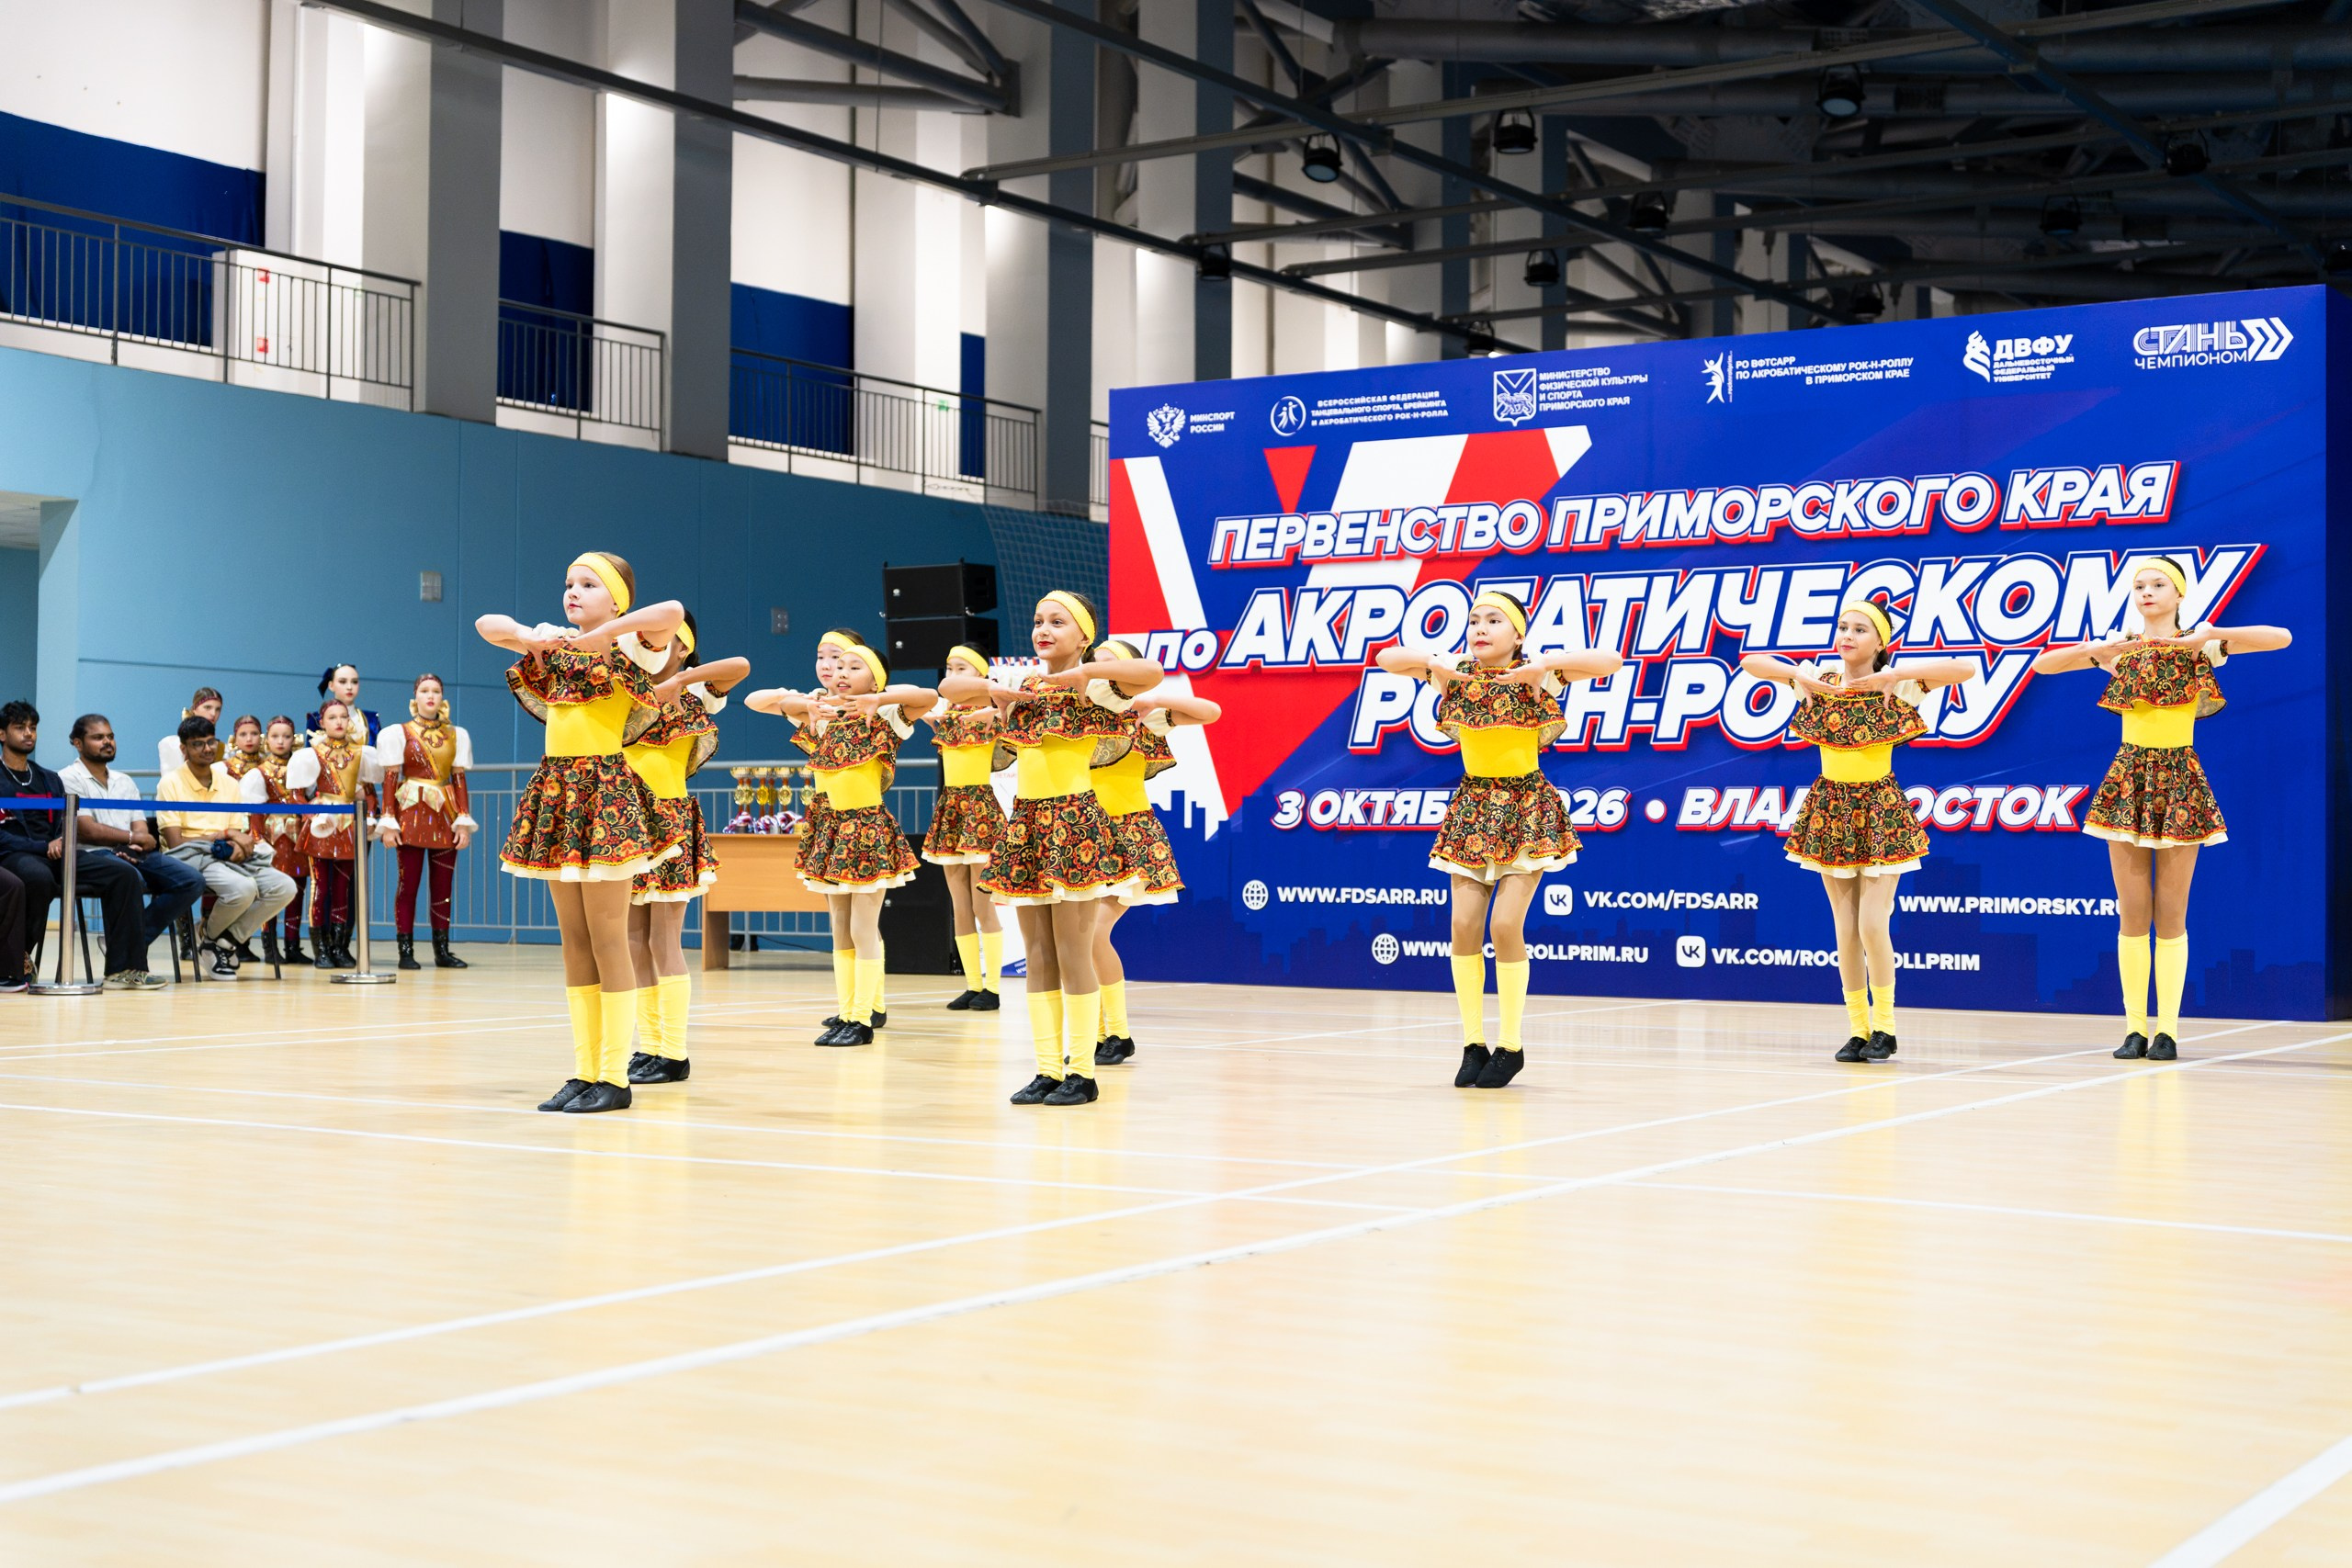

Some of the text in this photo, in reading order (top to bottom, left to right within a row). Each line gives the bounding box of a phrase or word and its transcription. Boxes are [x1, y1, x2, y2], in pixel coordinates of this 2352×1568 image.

[1994, 334, 2073, 361] ДВФУ
[1736, 356, 1796, 368] РО ВФТСАРР
[1736, 357, 1914, 379] ПО АКРОБАТИЧЕСКОМУ РОК-Н-РОЛЛУ
[2135, 350, 2247, 369] ЧЕМПИОНОМ
[1539, 367, 1611, 381] МИНИСТЕРСТВО
[1539, 374, 1648, 391] ФИЗИЧЕСКОЙ КУЛЬТУРЫ
[1805, 368, 1910, 385] В ПРИМОРСКОМ КРАЕ
[1317, 390, 1440, 408] ВСЕРОССИЙСКАЯ ФЕДЕРАЦИЯ
[1539, 390, 1583, 401] И СПОРТА
[1539, 396, 1631, 412] ПРИМОРСКОГО КРАЯ
[1190, 412, 1235, 423] МИНСПОРТ
[1318, 413, 1393, 426] АКРОБАТИЧЕСКОГО
[1395, 410, 1449, 420] РОК-Н-РОЛЛА
[1190, 423, 1225, 434] РОССИИ
[1208, 461, 2178, 567] ПЕРВЕНСТВО ПРИМОРСКОГО КРАЯ
[1144, 544, 2263, 673] ПО АКРОАТИЧЕСКОМУ
[1272, 787, 1305, 829] 3
[1308, 787, 1459, 829] ОКТЯБ
[1677, 785, 2088, 835] ВЛАОСТОК
[1277, 886, 1448, 906] WWW.FDSARR.RU
[1584, 889, 1759, 910] VK.COM/FDSARR
[1899, 896, 2120, 916] WWW.PRIMORSKY.R
